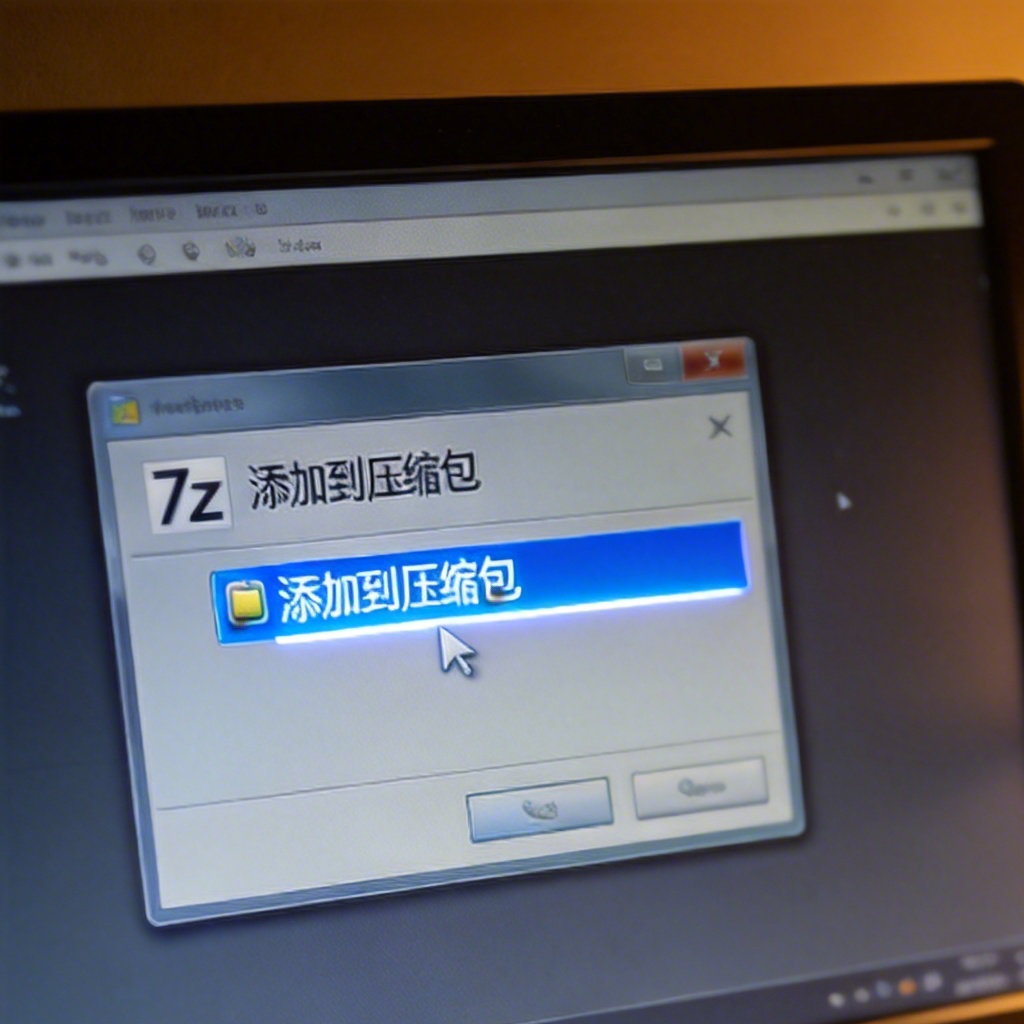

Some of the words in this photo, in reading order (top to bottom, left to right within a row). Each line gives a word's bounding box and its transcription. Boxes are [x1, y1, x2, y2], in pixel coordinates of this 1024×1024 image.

[249, 449, 482, 511] 添加到压缩包
[279, 556, 522, 623] 添加到压缩包
